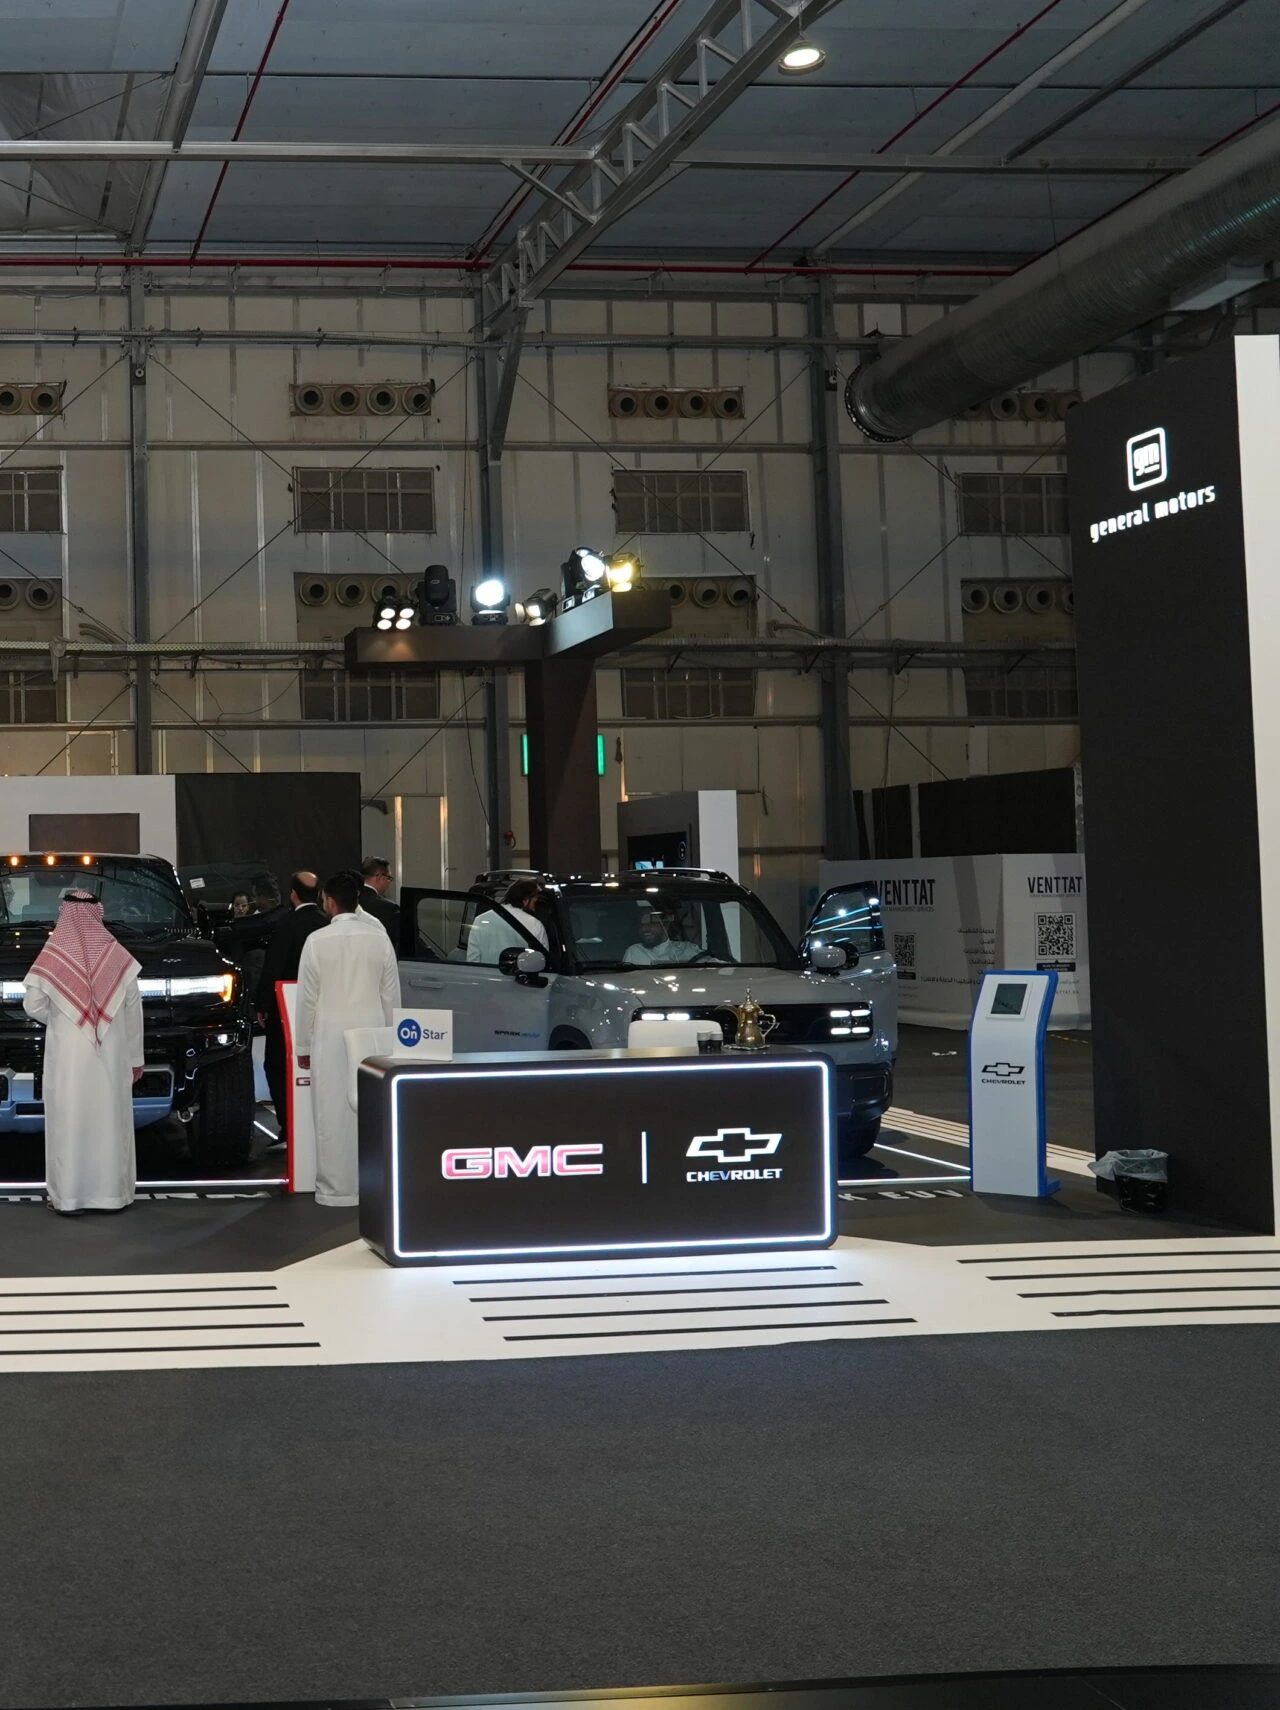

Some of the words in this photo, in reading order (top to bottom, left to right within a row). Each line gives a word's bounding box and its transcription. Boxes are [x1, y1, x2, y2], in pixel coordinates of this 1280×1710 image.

[1090, 502, 1150, 543] general
[1154, 485, 1216, 519] motors
[1028, 876, 1083, 894] VENTTAT
[441, 1143, 603, 1180] GMC
[686, 1168, 783, 1182] CHEVROLET
